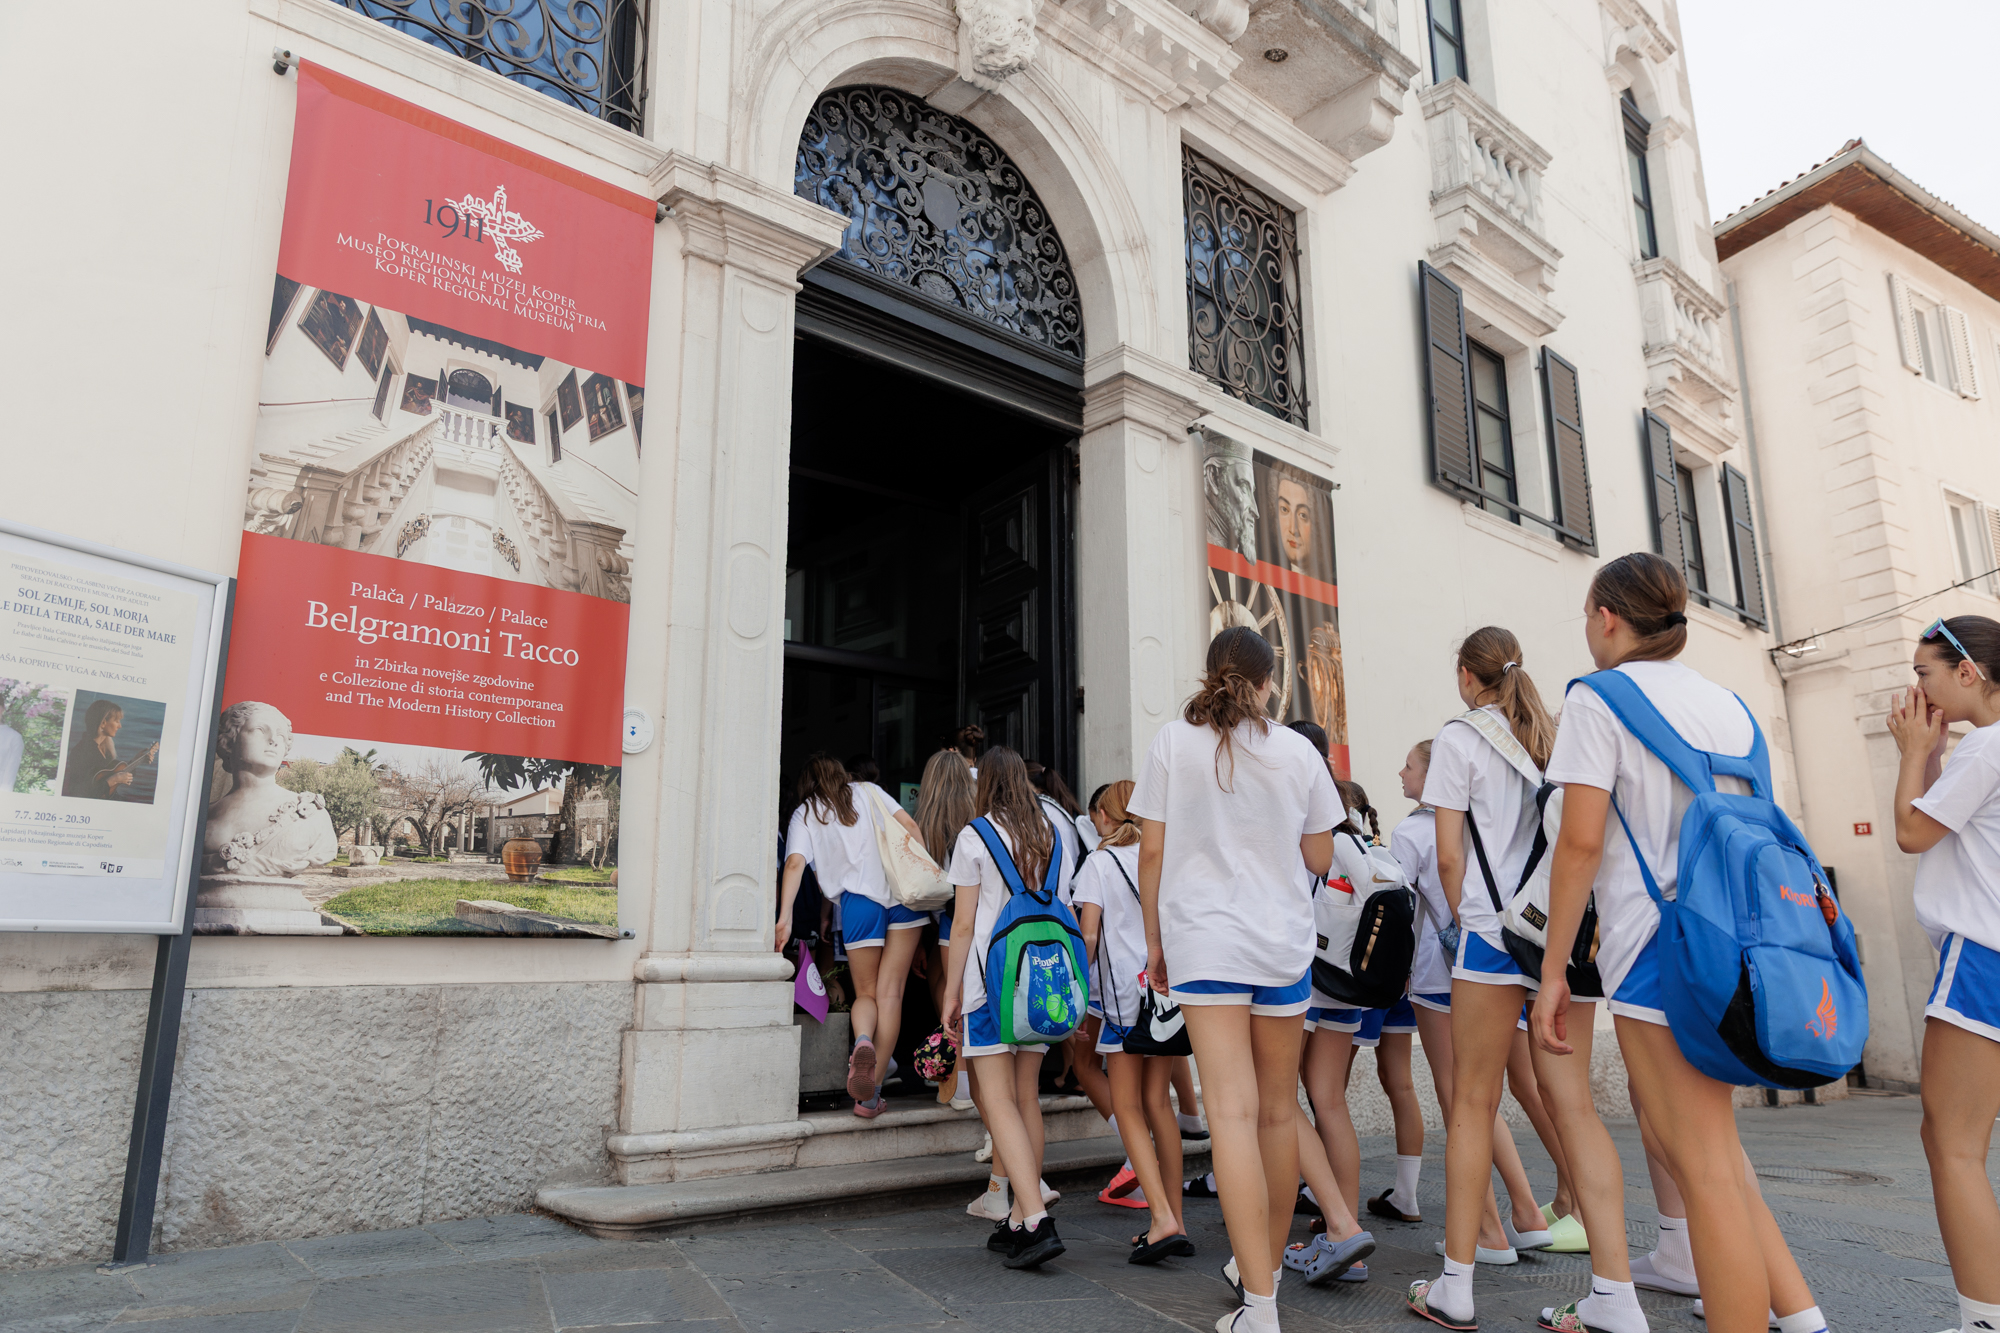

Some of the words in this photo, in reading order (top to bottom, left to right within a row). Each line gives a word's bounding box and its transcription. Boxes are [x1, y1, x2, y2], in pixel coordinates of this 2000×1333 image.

[423, 199, 484, 243] 1911
[336, 232, 396, 261] MUSEO
[515, 293, 607, 331] CAPODISTRIA
[375, 258, 427, 286] KOPER
[433, 278, 509, 312] REGIONAL
[514, 304, 575, 333] MUSEUM
[532, 286, 577, 310] KOPER
[17, 587, 41, 602] SOL
[43, 592, 88, 612] ZEMLJE,
[90, 602, 110, 616] SOL
[113, 607, 149, 624] MORJA
[20, 574, 45, 584] SERATA
[92, 588, 115, 600] MUSICA
[116, 594, 128, 602] PER
[77, 577, 106, 590] GLASBENI
[135, 591, 161, 602] ODRASLE
[350, 582, 404, 605] Palača
[423, 595, 485, 618] Palazzo
[501, 608, 548, 629] Palace
[13, 602, 51, 618] DELLA
[54, 610, 93, 628] TERRA,
[95, 619, 122, 633] SALE
[124, 625, 145, 639] DER
[147, 629, 177, 644] MARE
[304, 600, 491, 655] Belgramoni
[499, 631, 579, 667] Tacco
[19, 656, 63, 671] KOPRIVEC
[65, 664, 89, 675] VUGA
[99, 671, 120, 681] NIKA
[122, 674, 147, 685] SOLCE
[355, 656, 369, 669] in
[374, 658, 418, 676] Zbirka
[422, 667, 469, 684] novejše
[473, 673, 535, 691] zgodovine
[319, 673, 328, 682] e
[332, 672, 407, 692] Collezione
[411, 680, 424, 694] di
[428, 685, 464, 700] storia
[468, 691, 564, 712] contemporanea
[325, 691, 352, 704] and
[356, 692, 384, 708] The
[388, 697, 441, 714] Modern
[445, 705, 492, 723] History
[495, 710, 556, 728] Collection
[34, 812, 57, 822] 2026
[65, 814, 91, 824] 20.30
[1857, 824, 1868, 834] 21
